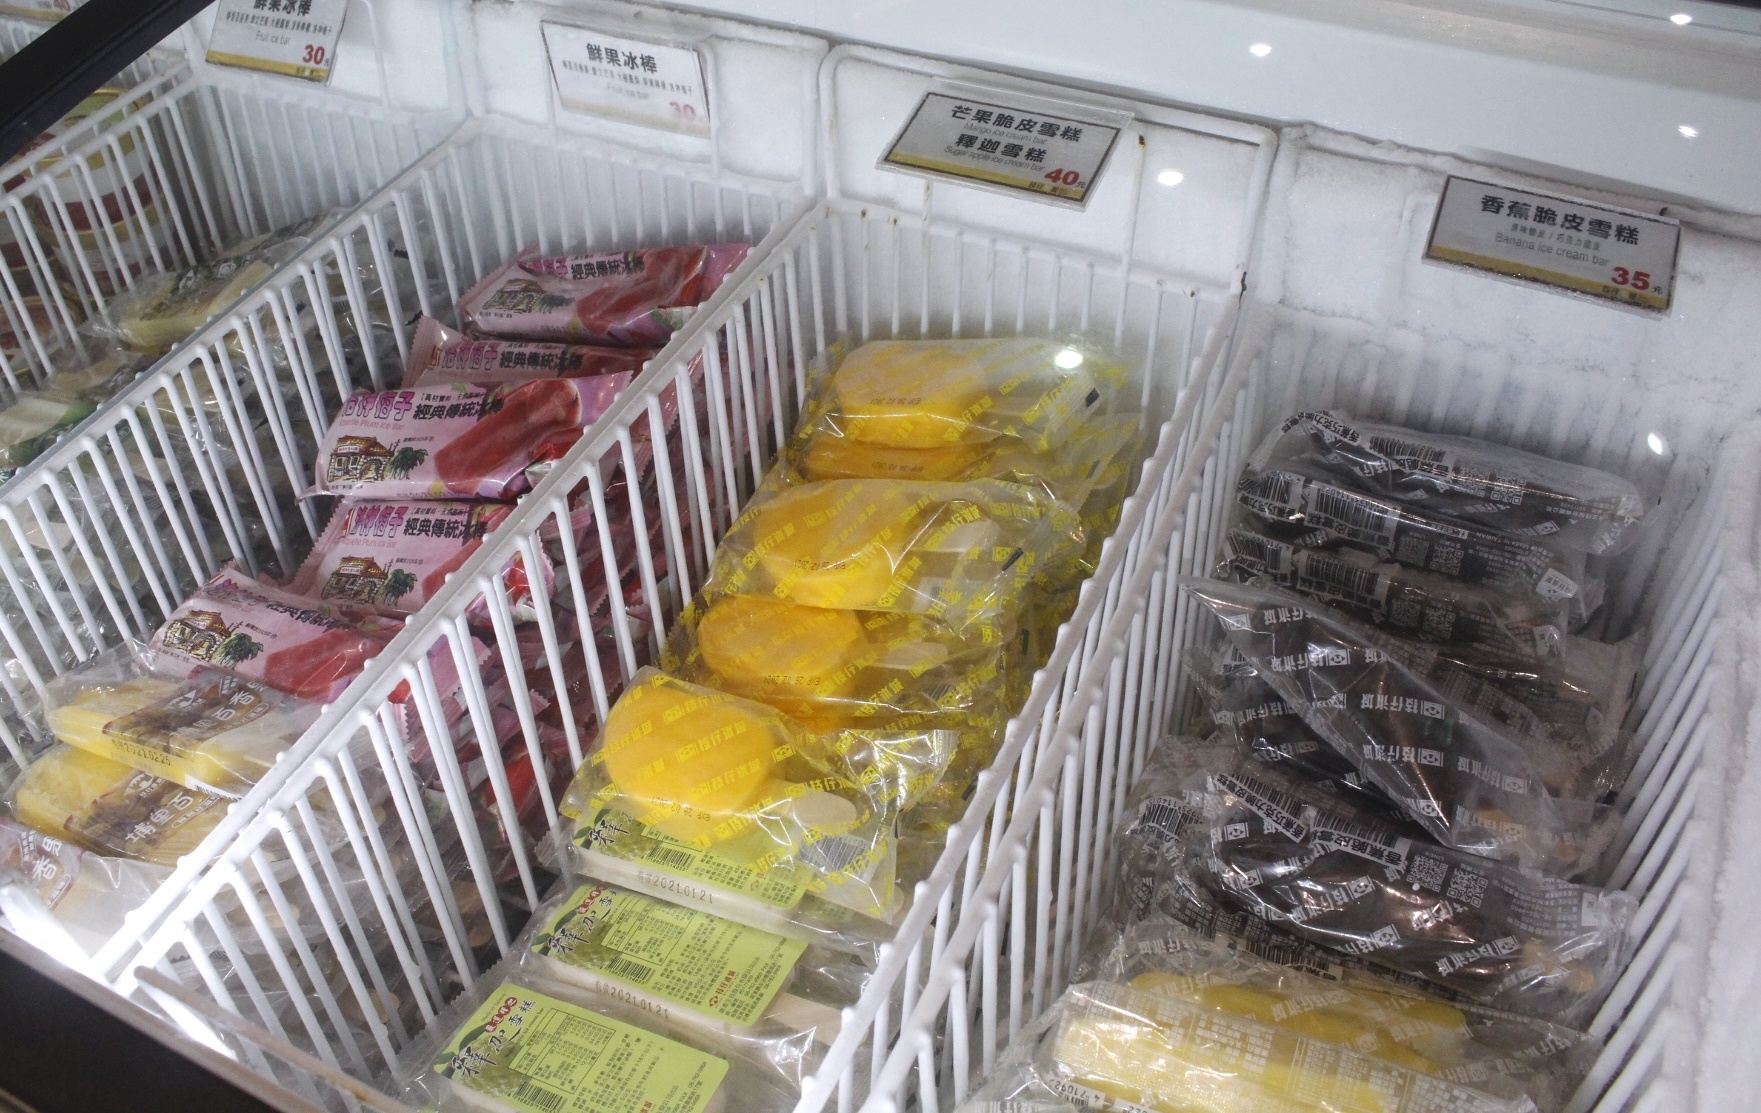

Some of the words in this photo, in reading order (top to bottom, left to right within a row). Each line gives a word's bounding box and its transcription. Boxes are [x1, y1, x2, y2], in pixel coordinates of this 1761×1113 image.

[256, 30, 270, 41] Fruit
[271, 34, 279, 43] ice
[280, 35, 291, 45] bar
[303, 44, 324, 65] 30
[587, 43, 657, 74] 鮮果冰棒
[951, 105, 1082, 142] 芒果脆皮雪糕
[964, 122, 991, 135] Mango
[992, 128, 1004, 137] ice
[1005, 131, 1030, 142] cream
[1033, 135, 1048, 144] bar
[944, 145, 966, 157] Sugar
[968, 149, 991, 162] apple
[992, 153, 1003, 163] ice
[1004, 157, 1028, 168] cream
[1030, 161, 1045, 171] bar
[955, 133, 1046, 163] 釋迦雪糕
[1045, 168, 1079, 186] 40
[1076, 181, 1086, 189] 元
[1481, 194, 1640, 245] 香蕉脆皮雪糕
[1495, 232, 1535, 251] Banana
[1538, 242, 1553, 254] ice
[1555, 248, 1589, 262] cream
[1592, 255, 1610, 267] bar
[1611, 266, 1650, 291] 35
[1652, 285, 1663, 295] 元
[412, 399, 504, 421] 經典傳統冰棒
[360, 420, 379, 429] Plum
[380, 421, 390, 429] Ice
[391, 423, 405, 431] Bar
[402, 518, 488, 541] 經典傳統冰棒
[806, 676, 820, 685] EXP
